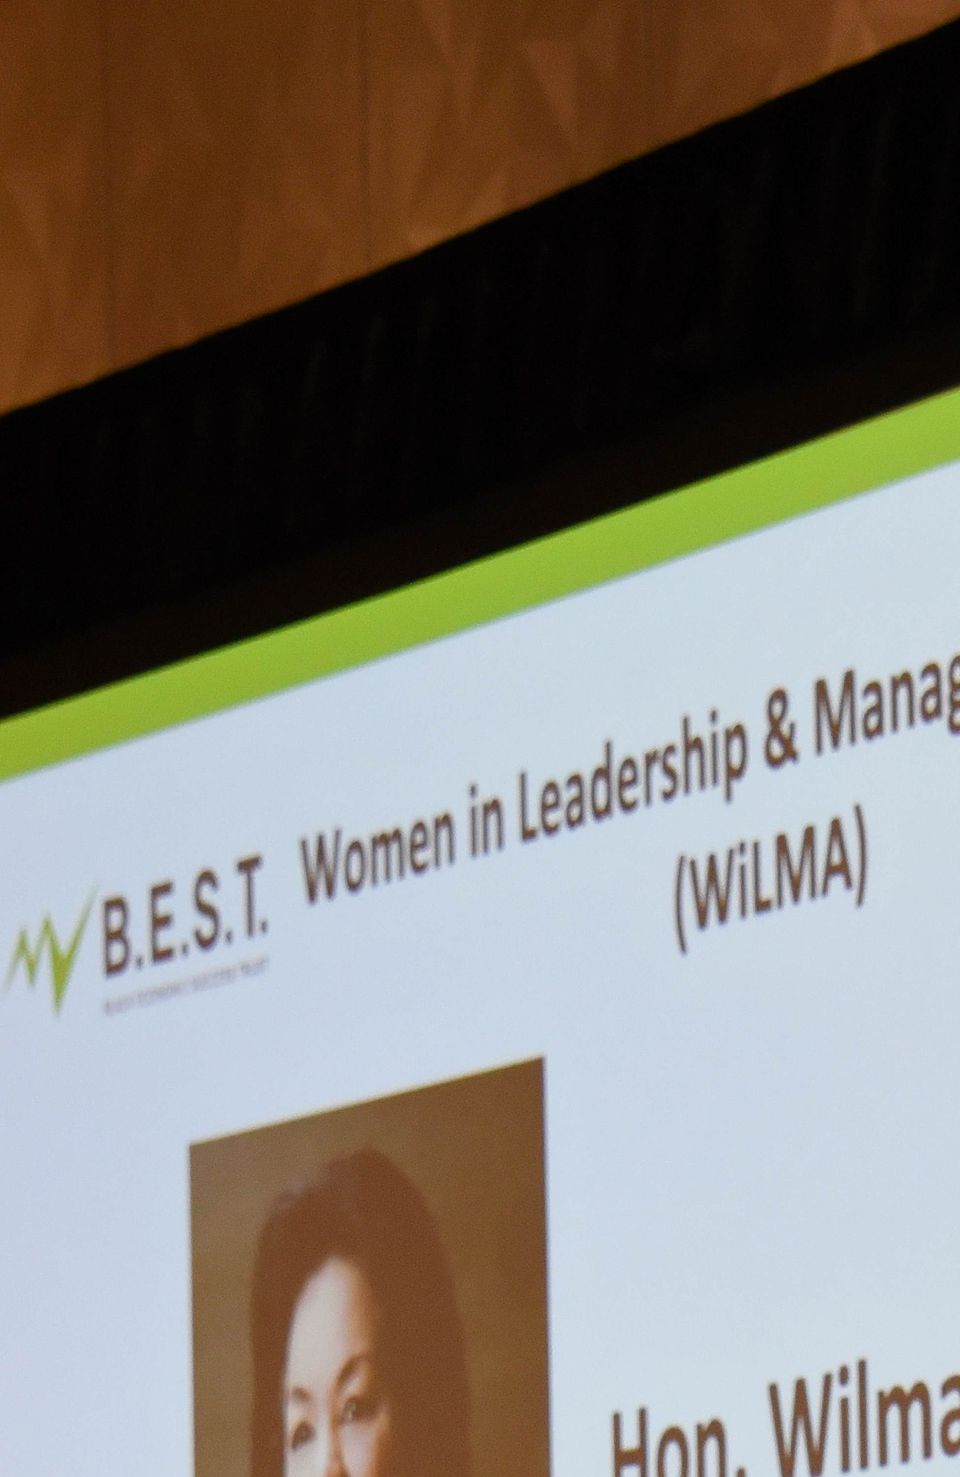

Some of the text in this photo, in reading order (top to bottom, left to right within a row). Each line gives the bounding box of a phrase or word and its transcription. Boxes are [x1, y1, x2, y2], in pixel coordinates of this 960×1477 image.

[302, 809, 456, 905] Women
[469, 783, 503, 859] in
[518, 708, 749, 844] Leadership
[763, 686, 799, 771] &
[102, 854, 270, 978] B.E.S.T.
[673, 803, 868, 955] (WiLMA)
